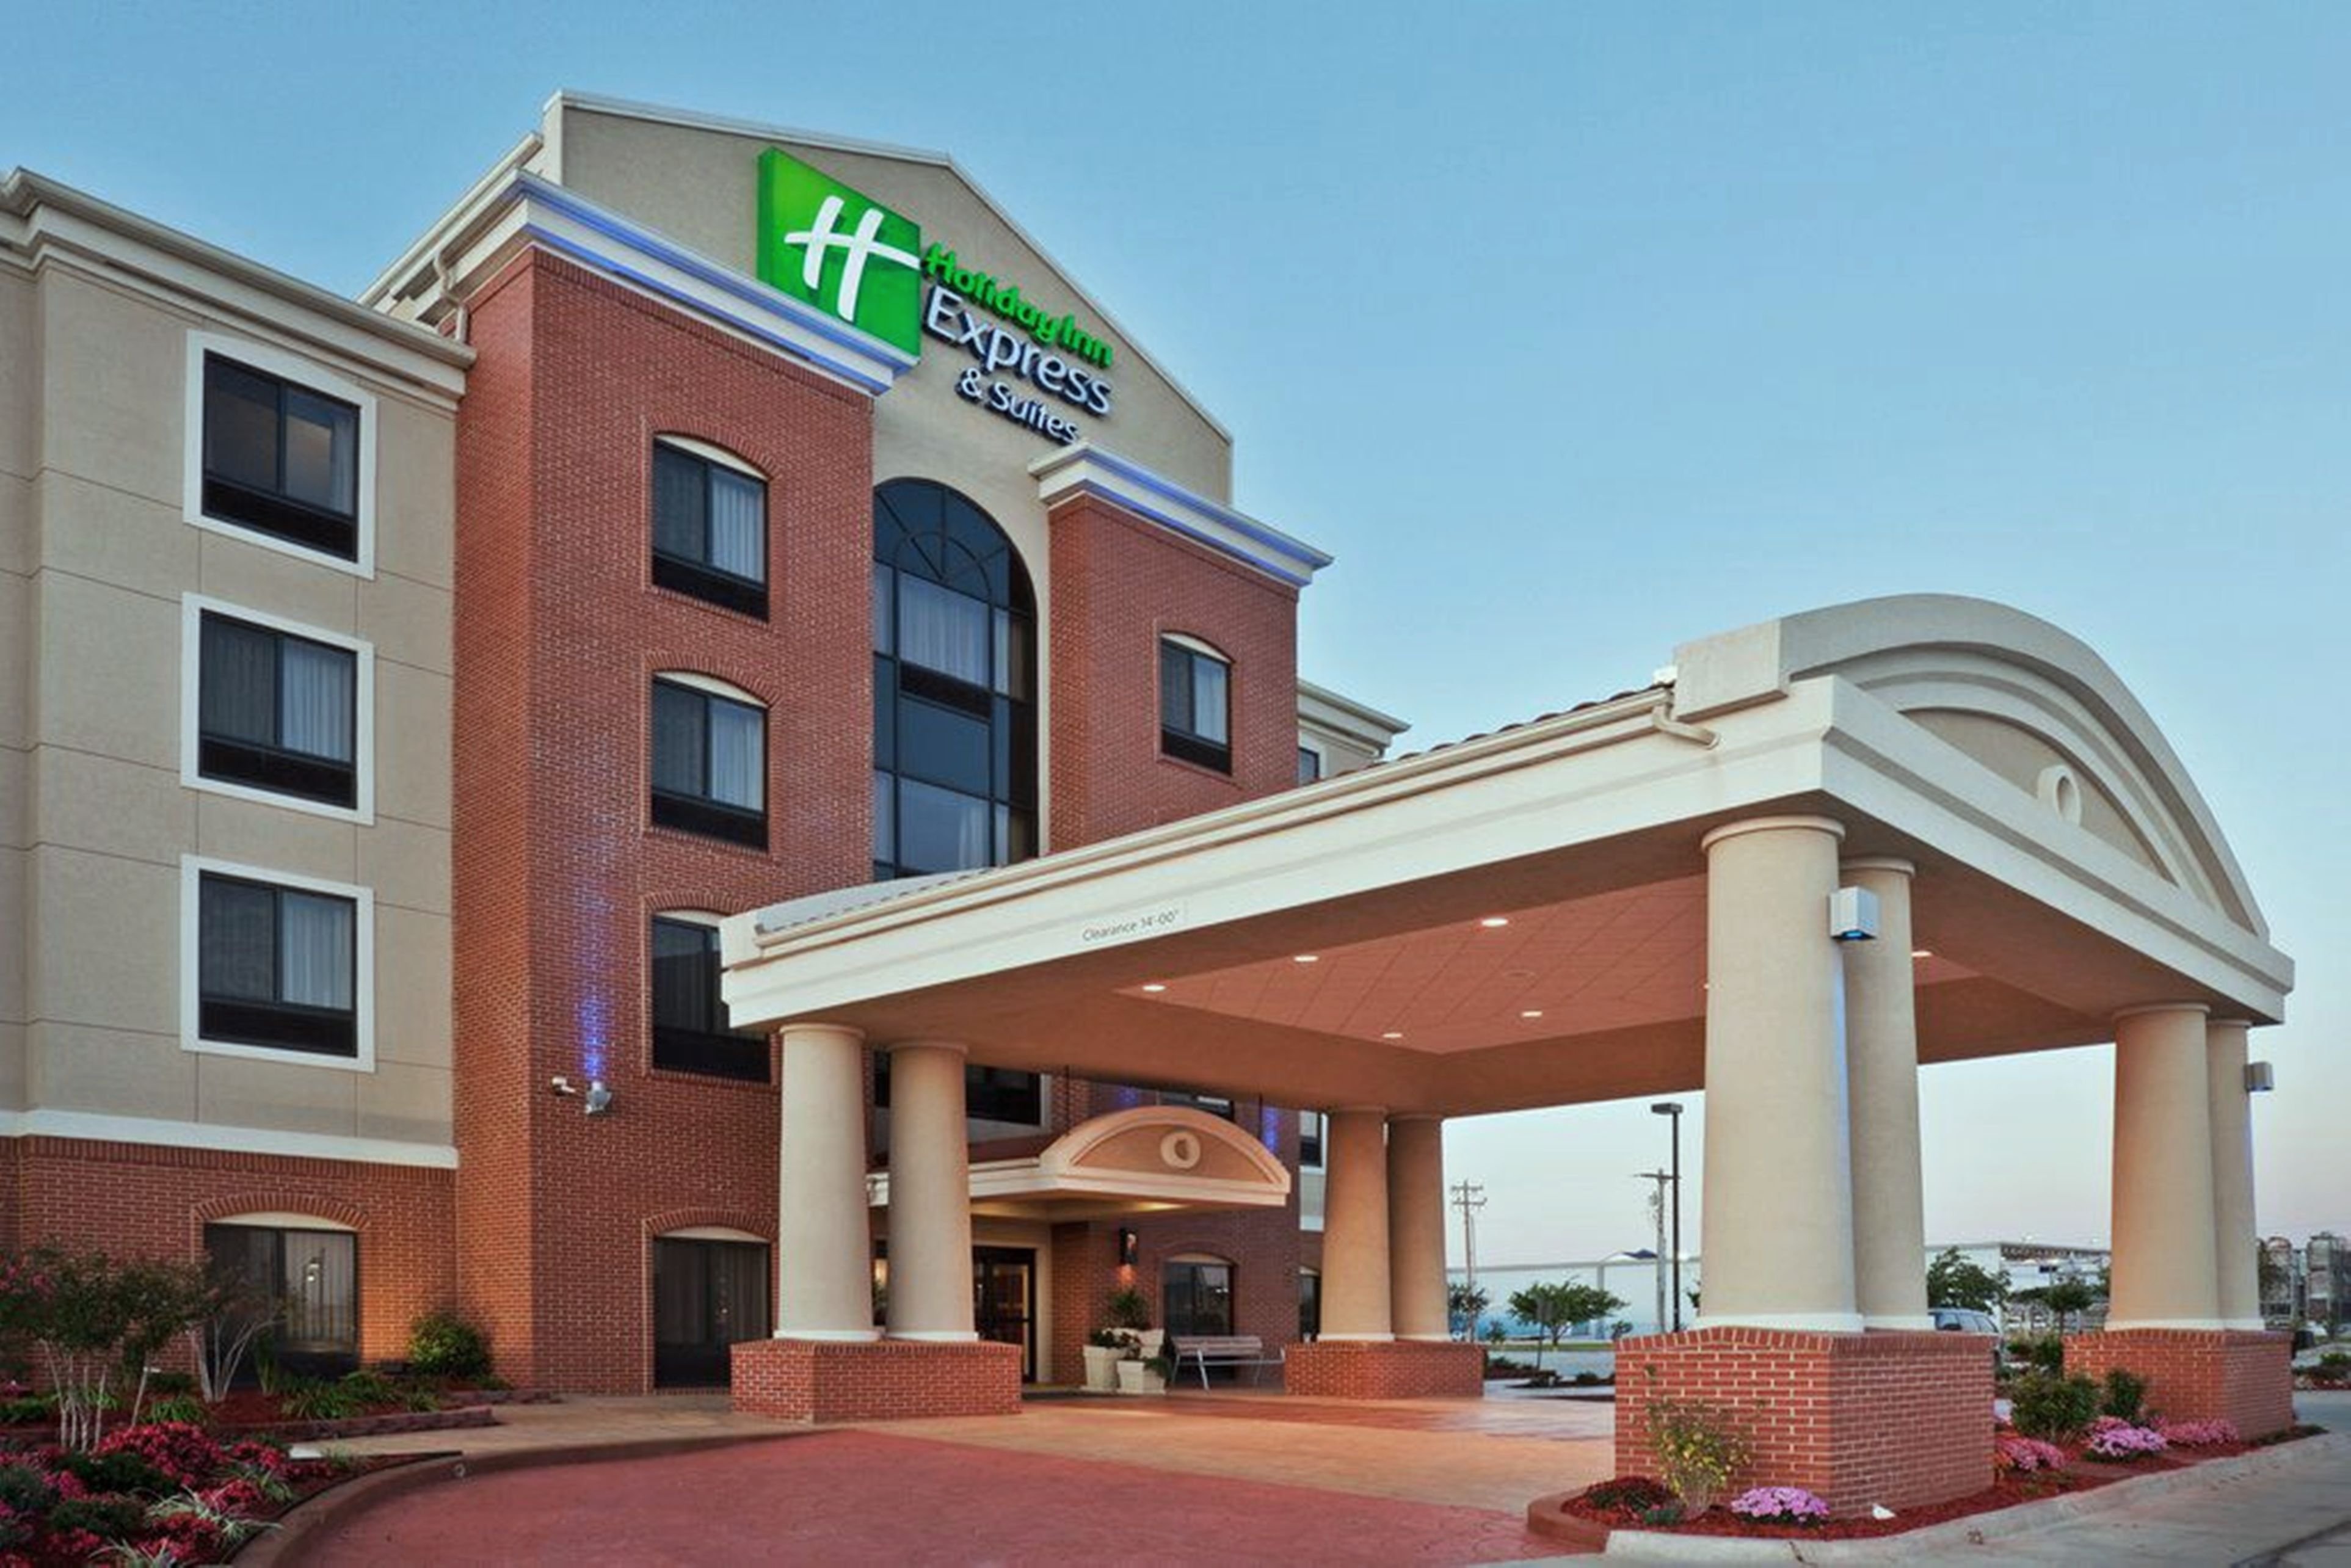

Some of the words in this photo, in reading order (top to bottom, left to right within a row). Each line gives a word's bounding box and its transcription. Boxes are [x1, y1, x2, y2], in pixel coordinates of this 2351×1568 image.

[924, 242, 1061, 345] Holiday
[1060, 310, 1114, 368] Inn
[926, 285, 1111, 414] Express
[959, 368, 983, 399] &
[990, 381, 1078, 445] Suites
[1082, 921, 1138, 942] Clearance
